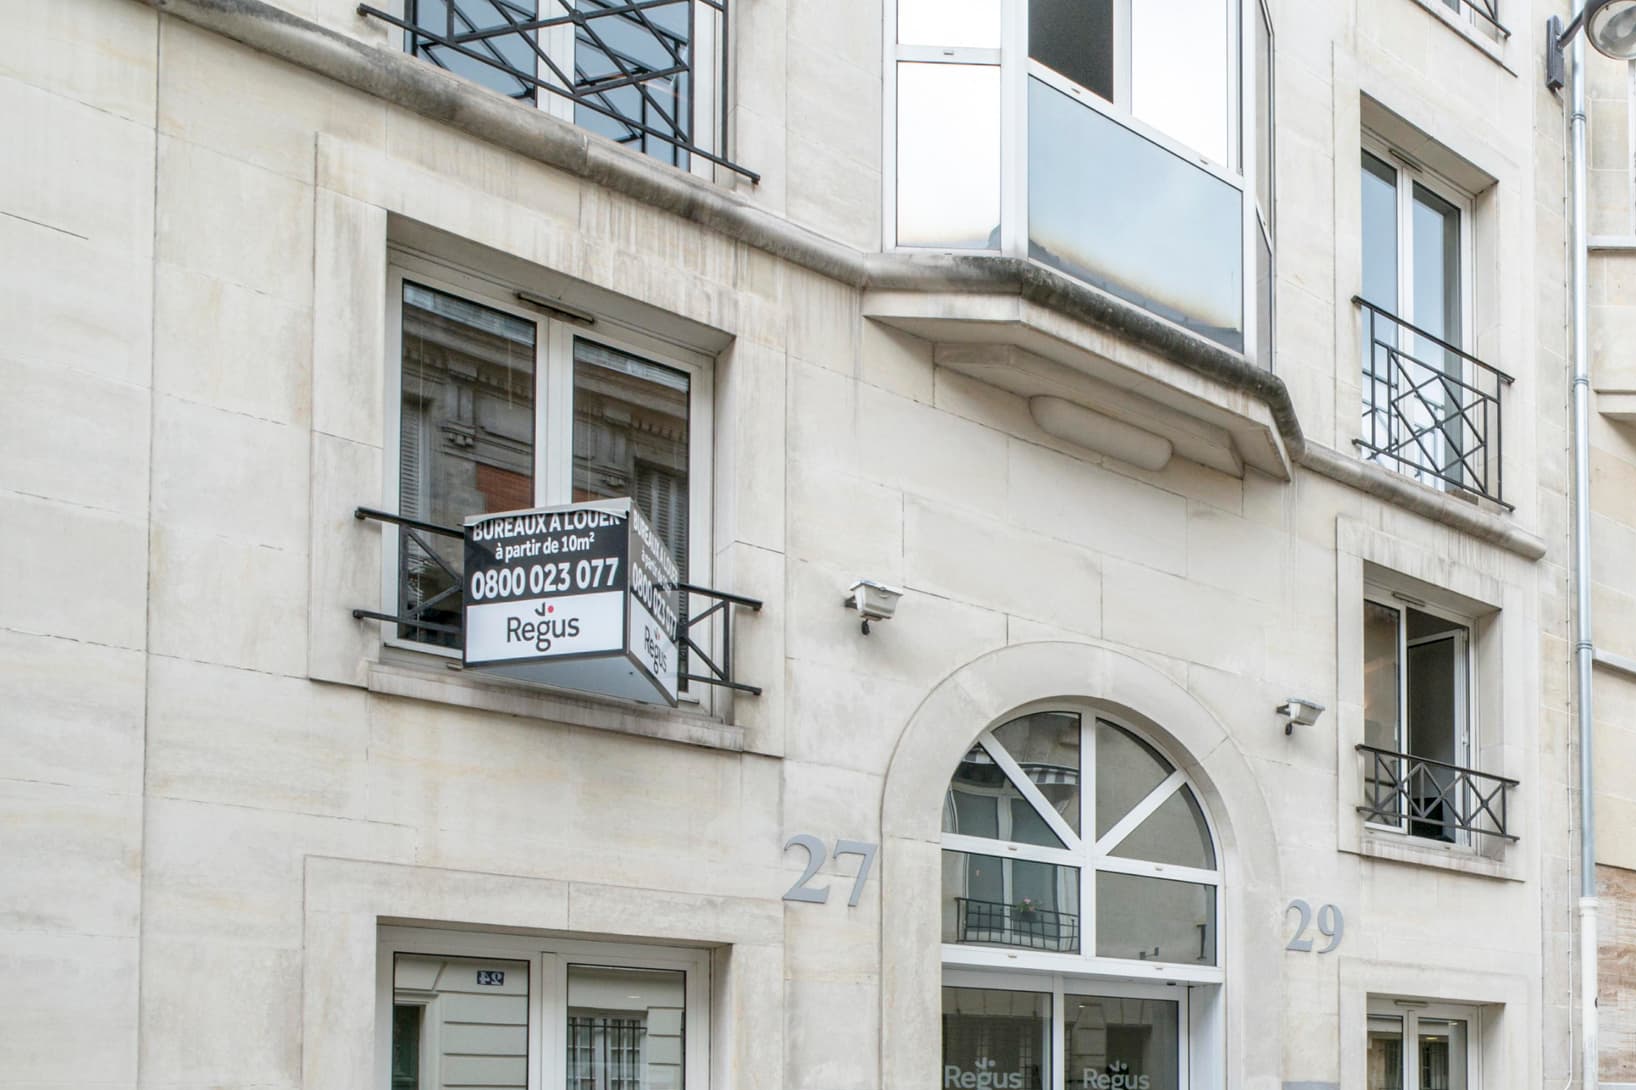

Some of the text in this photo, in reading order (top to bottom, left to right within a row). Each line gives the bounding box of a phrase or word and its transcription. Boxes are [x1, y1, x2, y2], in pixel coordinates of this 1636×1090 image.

[472, 513, 547, 541] BUREAUX
[495, 541, 503, 561] à
[505, 538, 541, 563] partir
[543, 537, 559, 555] de
[471, 557, 619, 600] 0800 023 077
[632, 562, 652, 608] 0800
[506, 616, 580, 651] Regus
[644, 625, 668, 674] Regus
[782, 834, 878, 908] 27
[1285, 899, 1344, 954] 29
